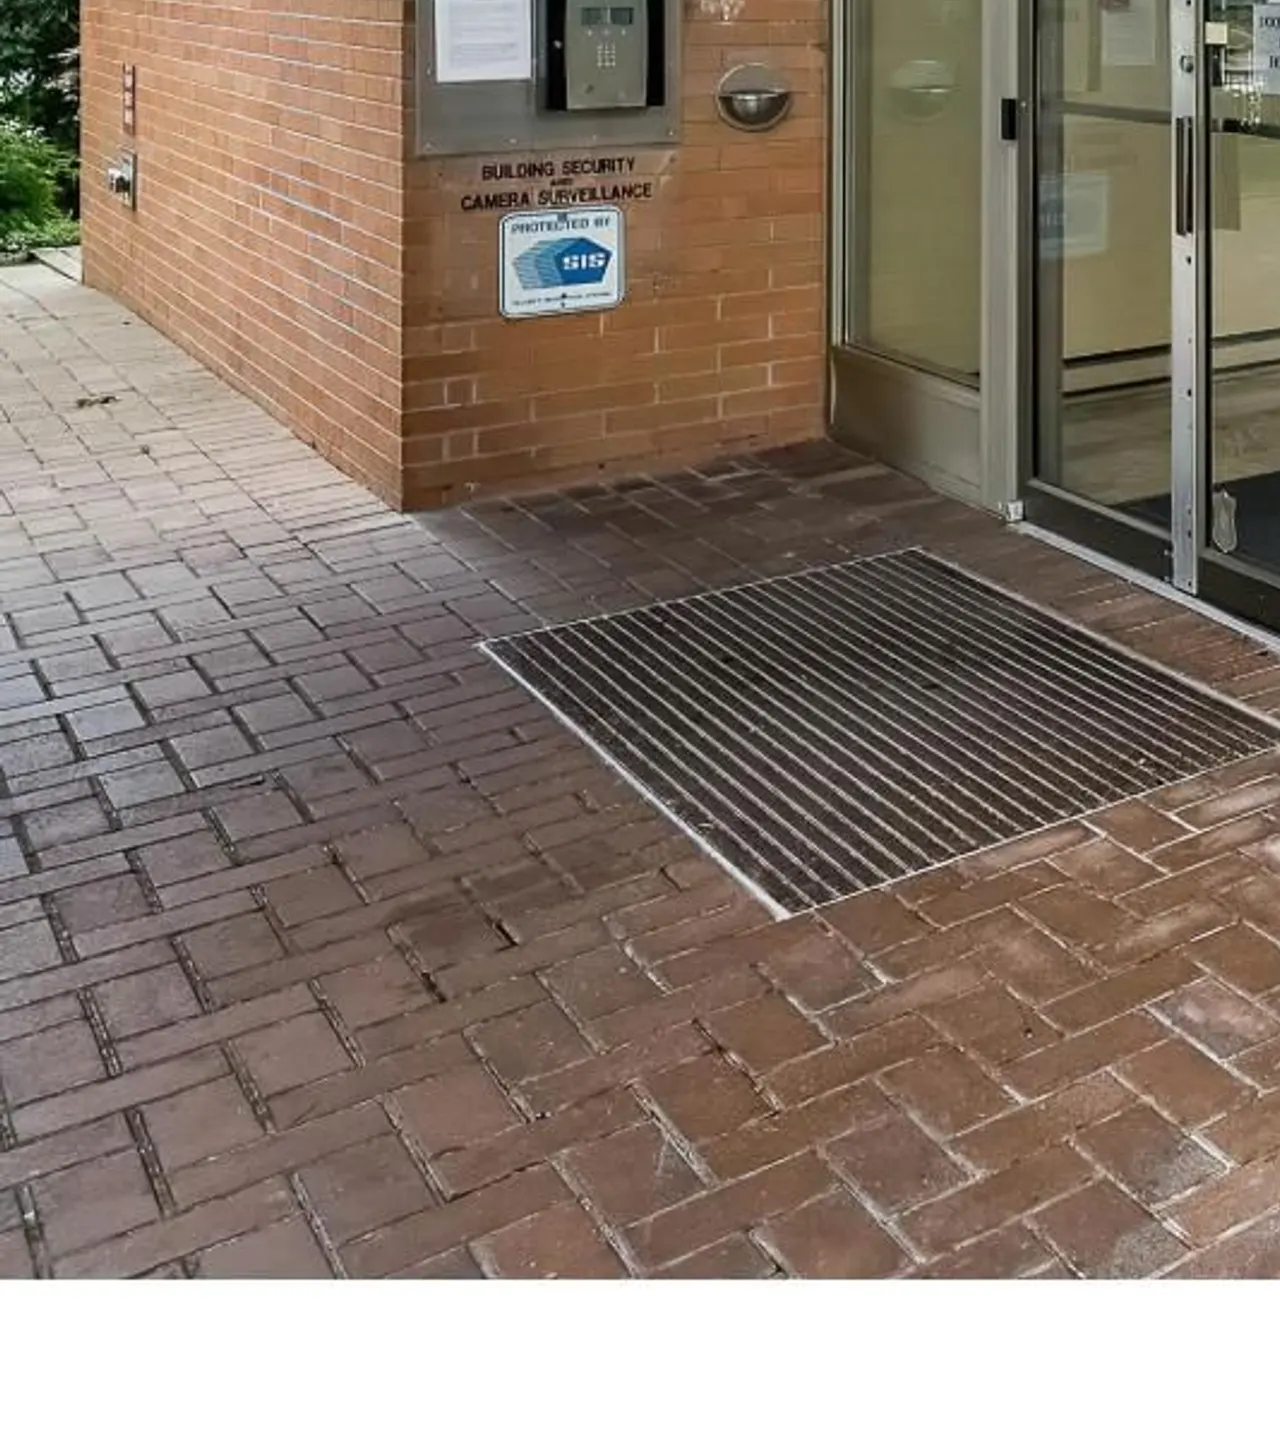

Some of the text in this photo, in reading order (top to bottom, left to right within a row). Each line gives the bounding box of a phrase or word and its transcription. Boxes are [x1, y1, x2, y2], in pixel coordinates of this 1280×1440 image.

[482, 157, 636, 180] BUILDING SECURITY
[461, 183, 653, 211] CAMERA SURVEILLANCE
[511, 218, 589, 234] PROTECTED
[562, 253, 606, 271] SIS
